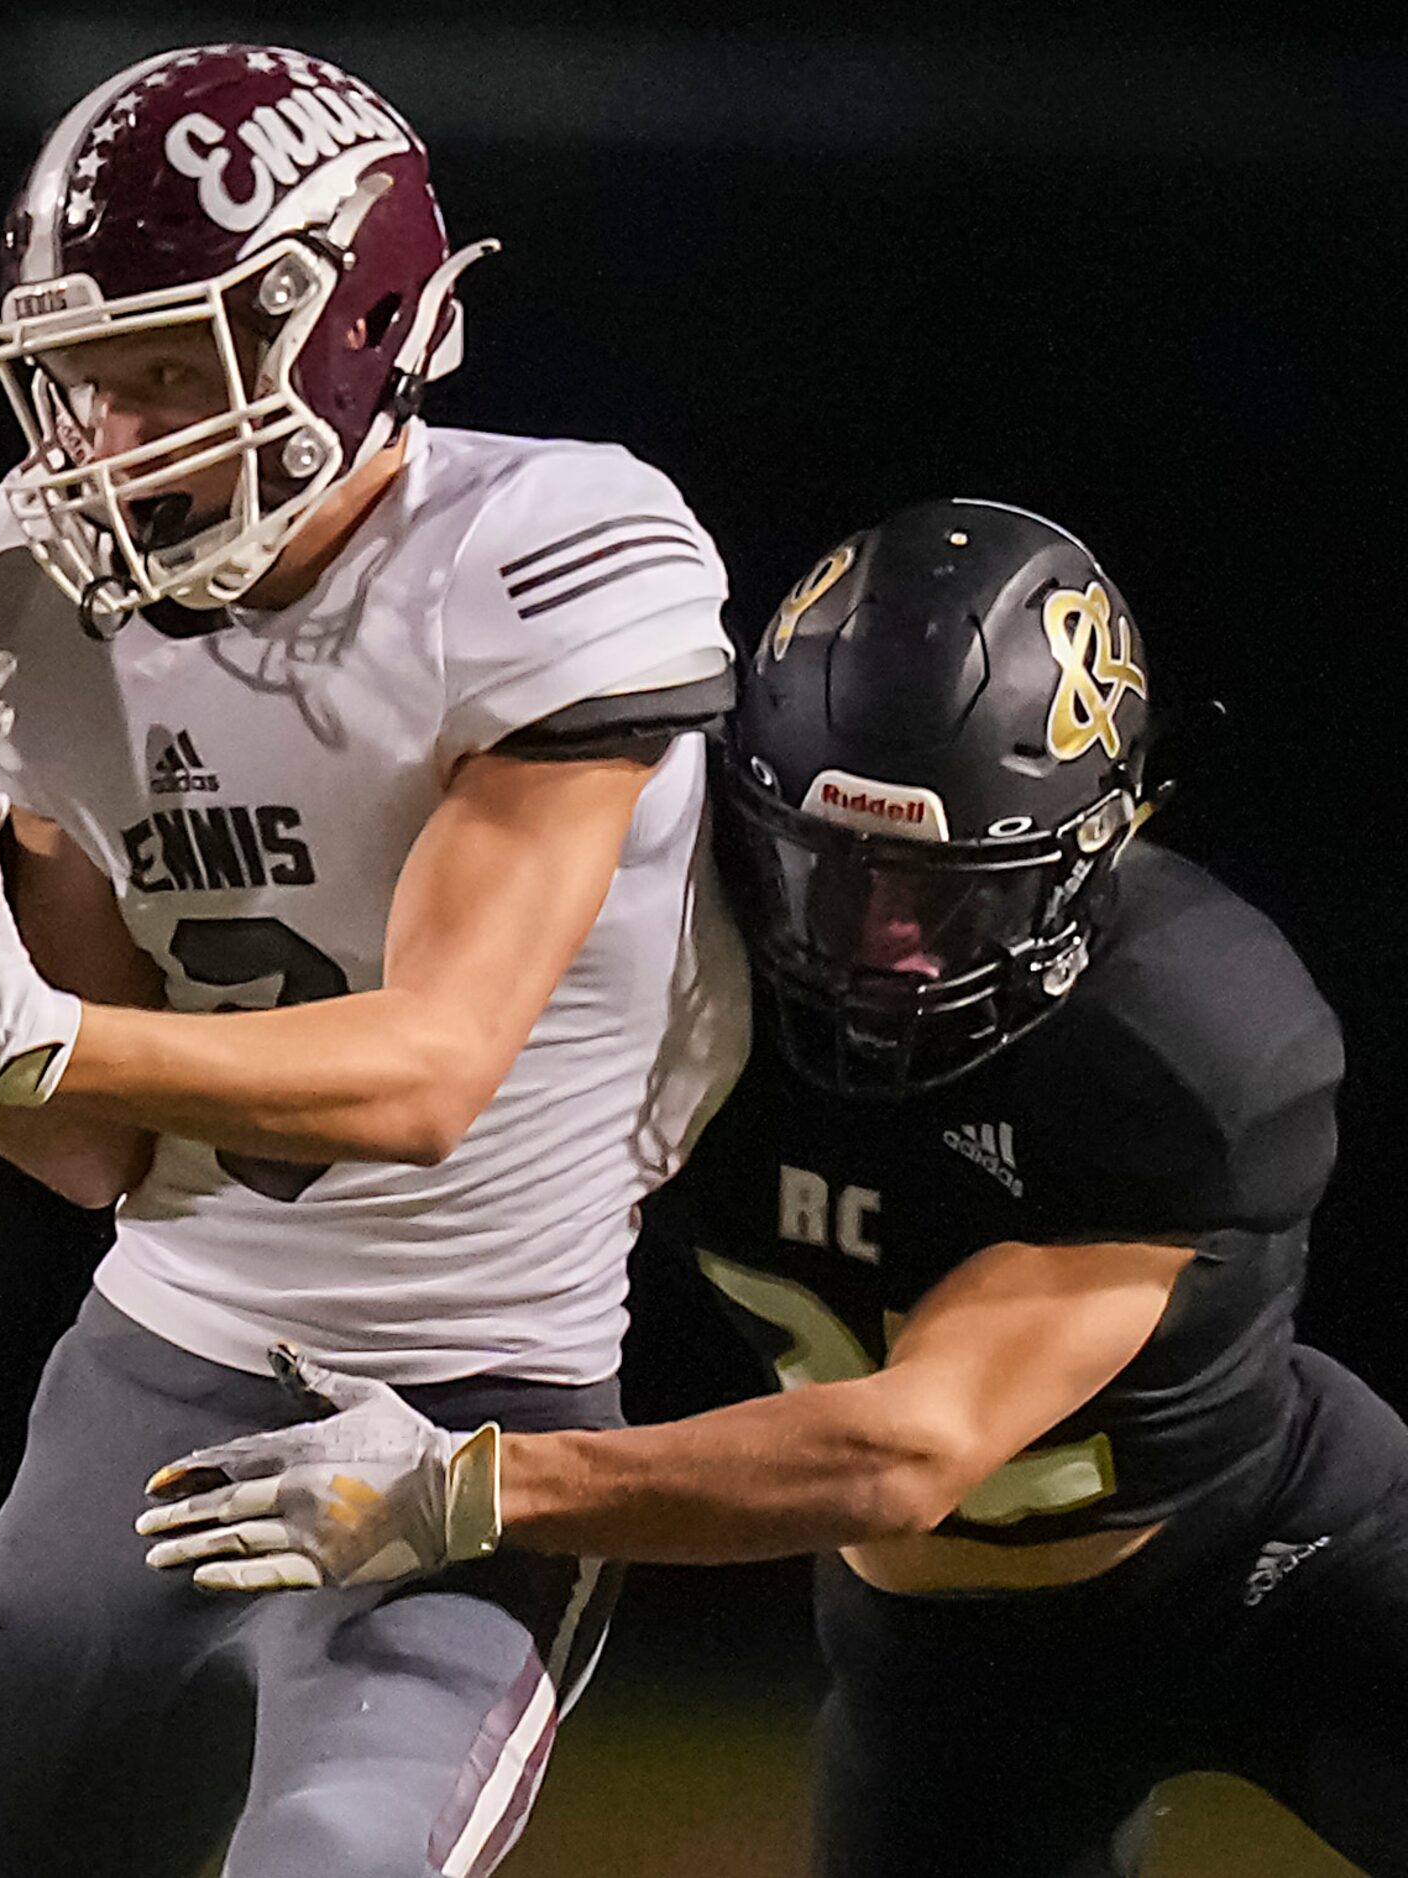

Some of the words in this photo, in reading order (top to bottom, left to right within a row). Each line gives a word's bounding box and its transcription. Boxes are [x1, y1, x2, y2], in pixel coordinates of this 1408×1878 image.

[821, 783, 925, 824] Riddell
[121, 805, 316, 893] ENNIS
[943, 1129, 1024, 1198] adidas
[779, 1164, 881, 1264] RC
